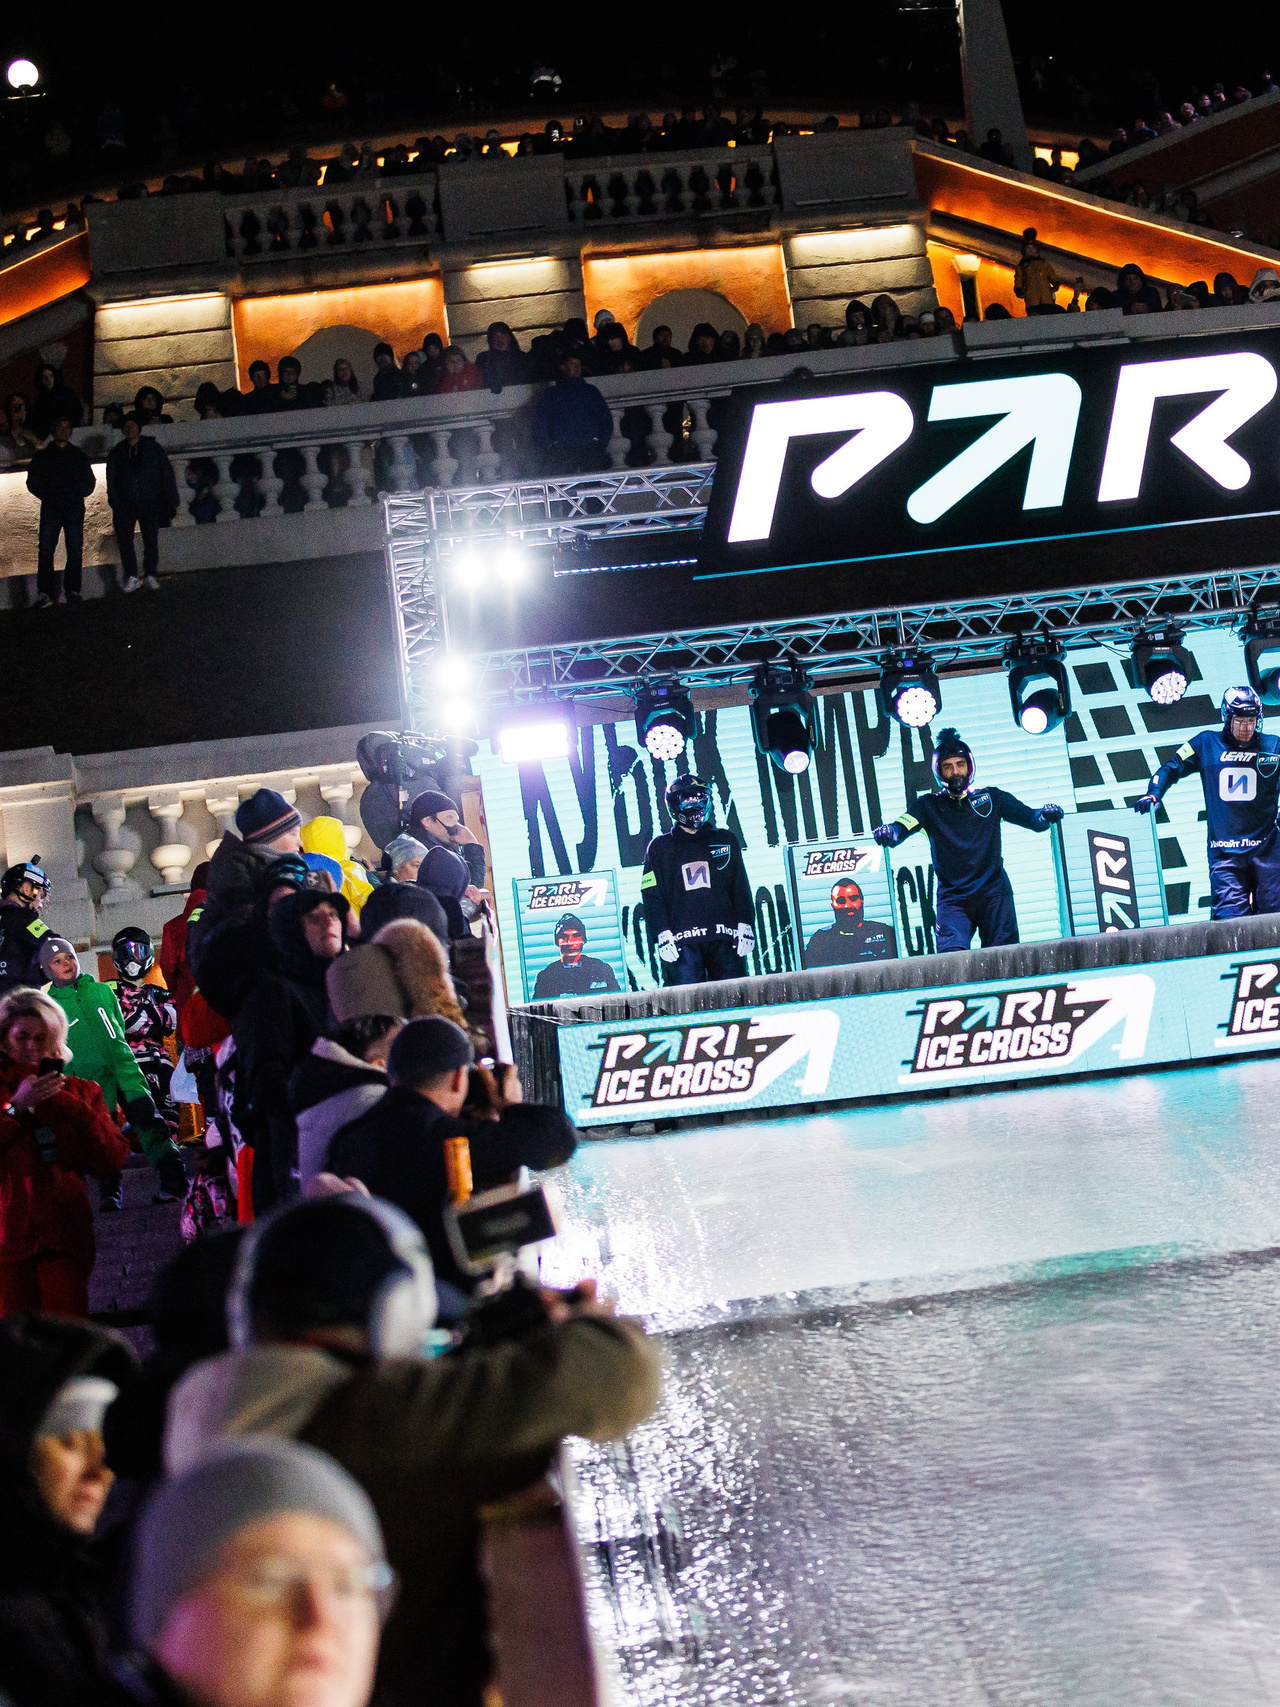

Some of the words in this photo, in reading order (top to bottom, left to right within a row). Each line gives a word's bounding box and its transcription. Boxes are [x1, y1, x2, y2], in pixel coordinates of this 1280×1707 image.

[1219, 750, 1257, 763] LEATT
[1258, 756, 1279, 764] PARI
[808, 849, 852, 864] PARI
[806, 862, 823, 874] ICE
[823, 859, 857, 873] CROSS
[533, 882, 577, 898] PARI
[531, 895, 548, 909] ICE
[547, 893, 581, 907] CROSS
[923, 989, 1057, 1036] PARI
[603, 1023, 740, 1069] PARI
[915, 1033, 969, 1070] ICE
[968, 1021, 1072, 1064] CROSS
[596, 1067, 651, 1104] ICE
[650, 1056, 754, 1099] CROSS
